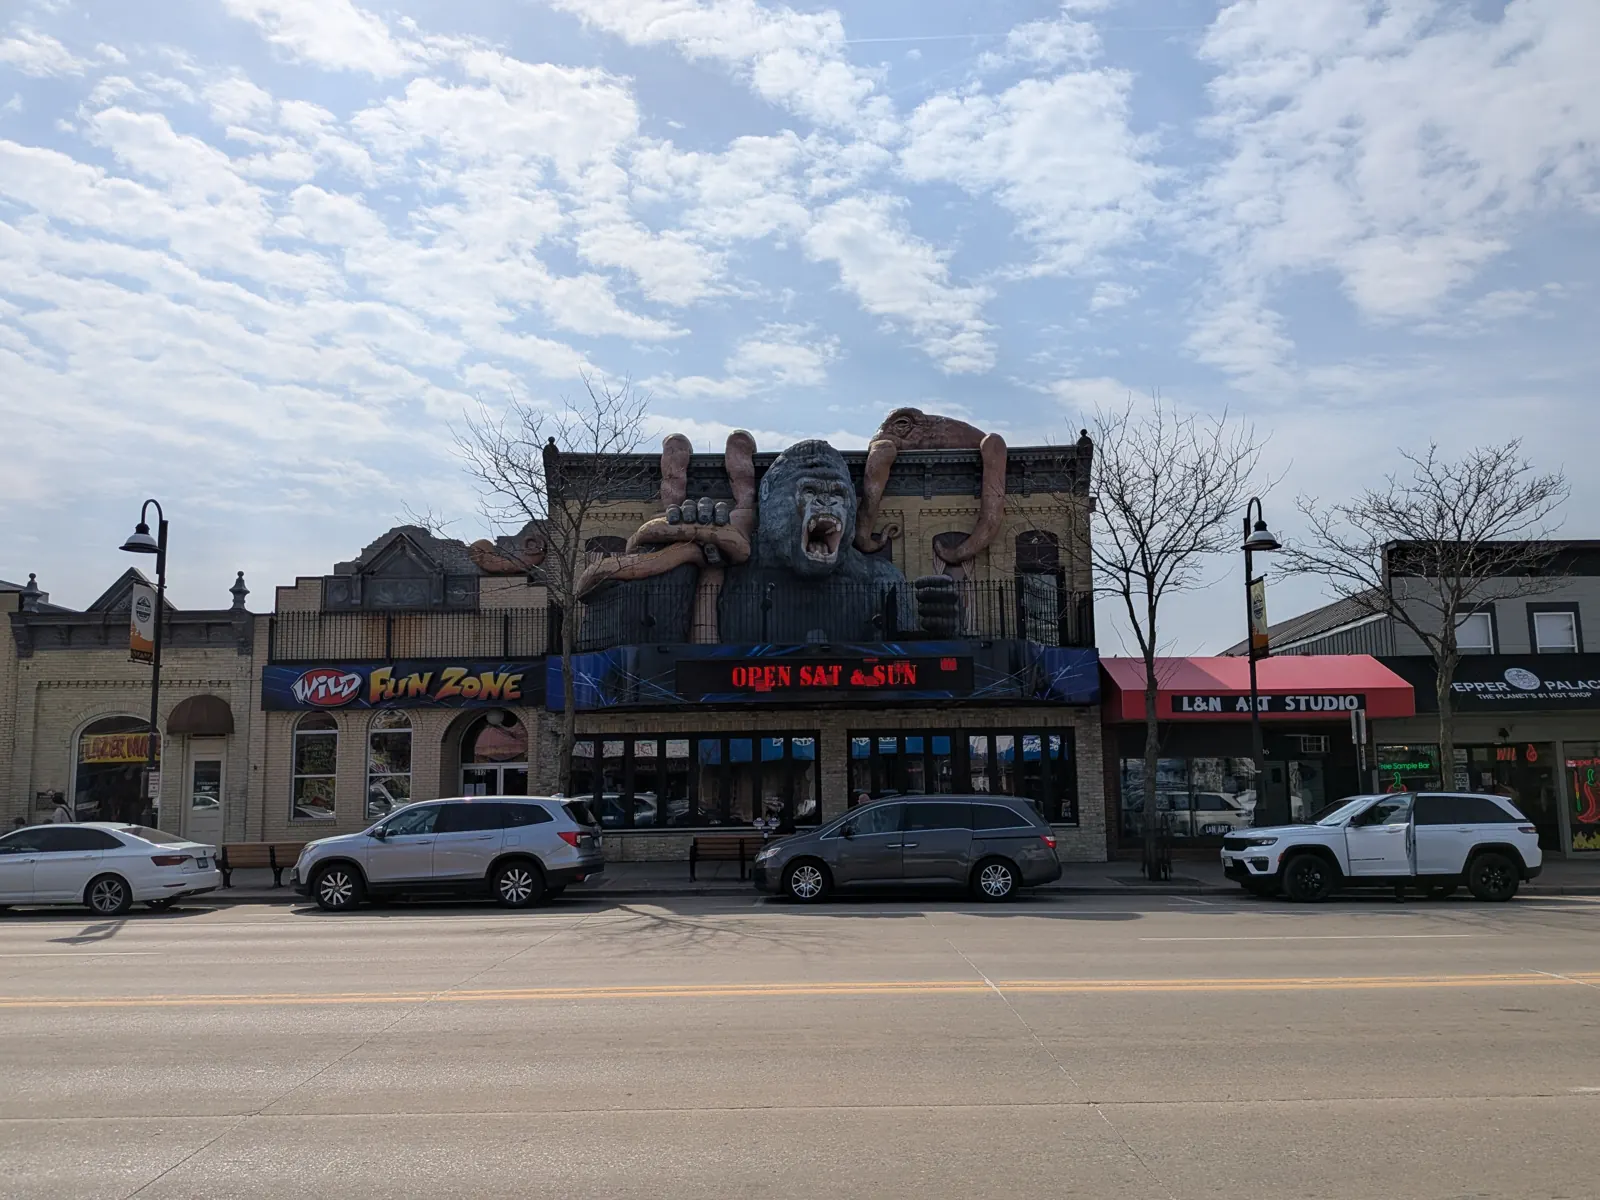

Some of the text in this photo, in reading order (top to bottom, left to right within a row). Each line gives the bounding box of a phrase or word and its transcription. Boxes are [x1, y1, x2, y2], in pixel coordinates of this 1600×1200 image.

[732, 664, 917, 688] OPEN SAT & SUN
[1450, 680, 1600, 692] EPPER PALAC
[1182, 696, 1221, 711] L&N
[1285, 695, 1359, 711] STUDIO
[1393, 762, 1417, 770] Sample
